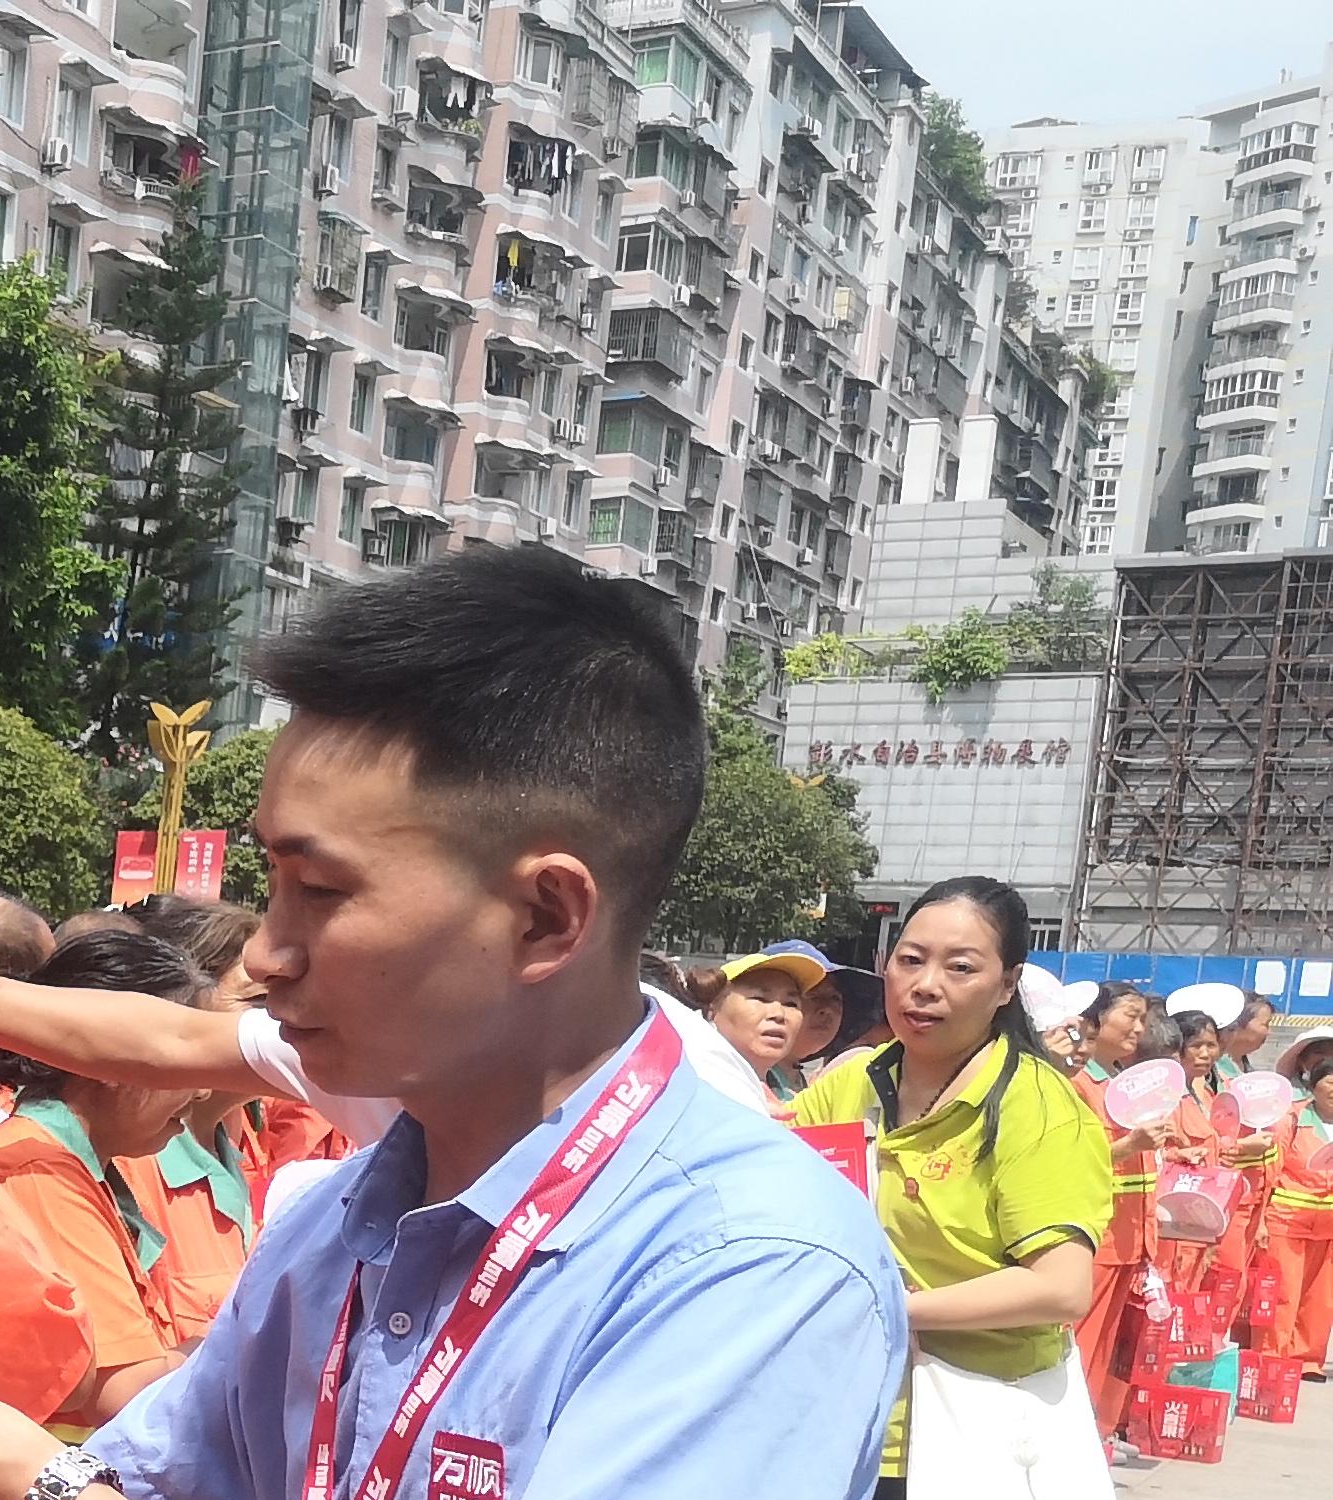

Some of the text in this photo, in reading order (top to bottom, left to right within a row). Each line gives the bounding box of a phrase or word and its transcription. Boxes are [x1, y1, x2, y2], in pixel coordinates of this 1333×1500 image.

[561, 1071, 652, 1174] 万顺叫车
[469, 1201, 552, 1308] 万顺叫车
[394, 1336, 463, 1438] 万顺叫车
